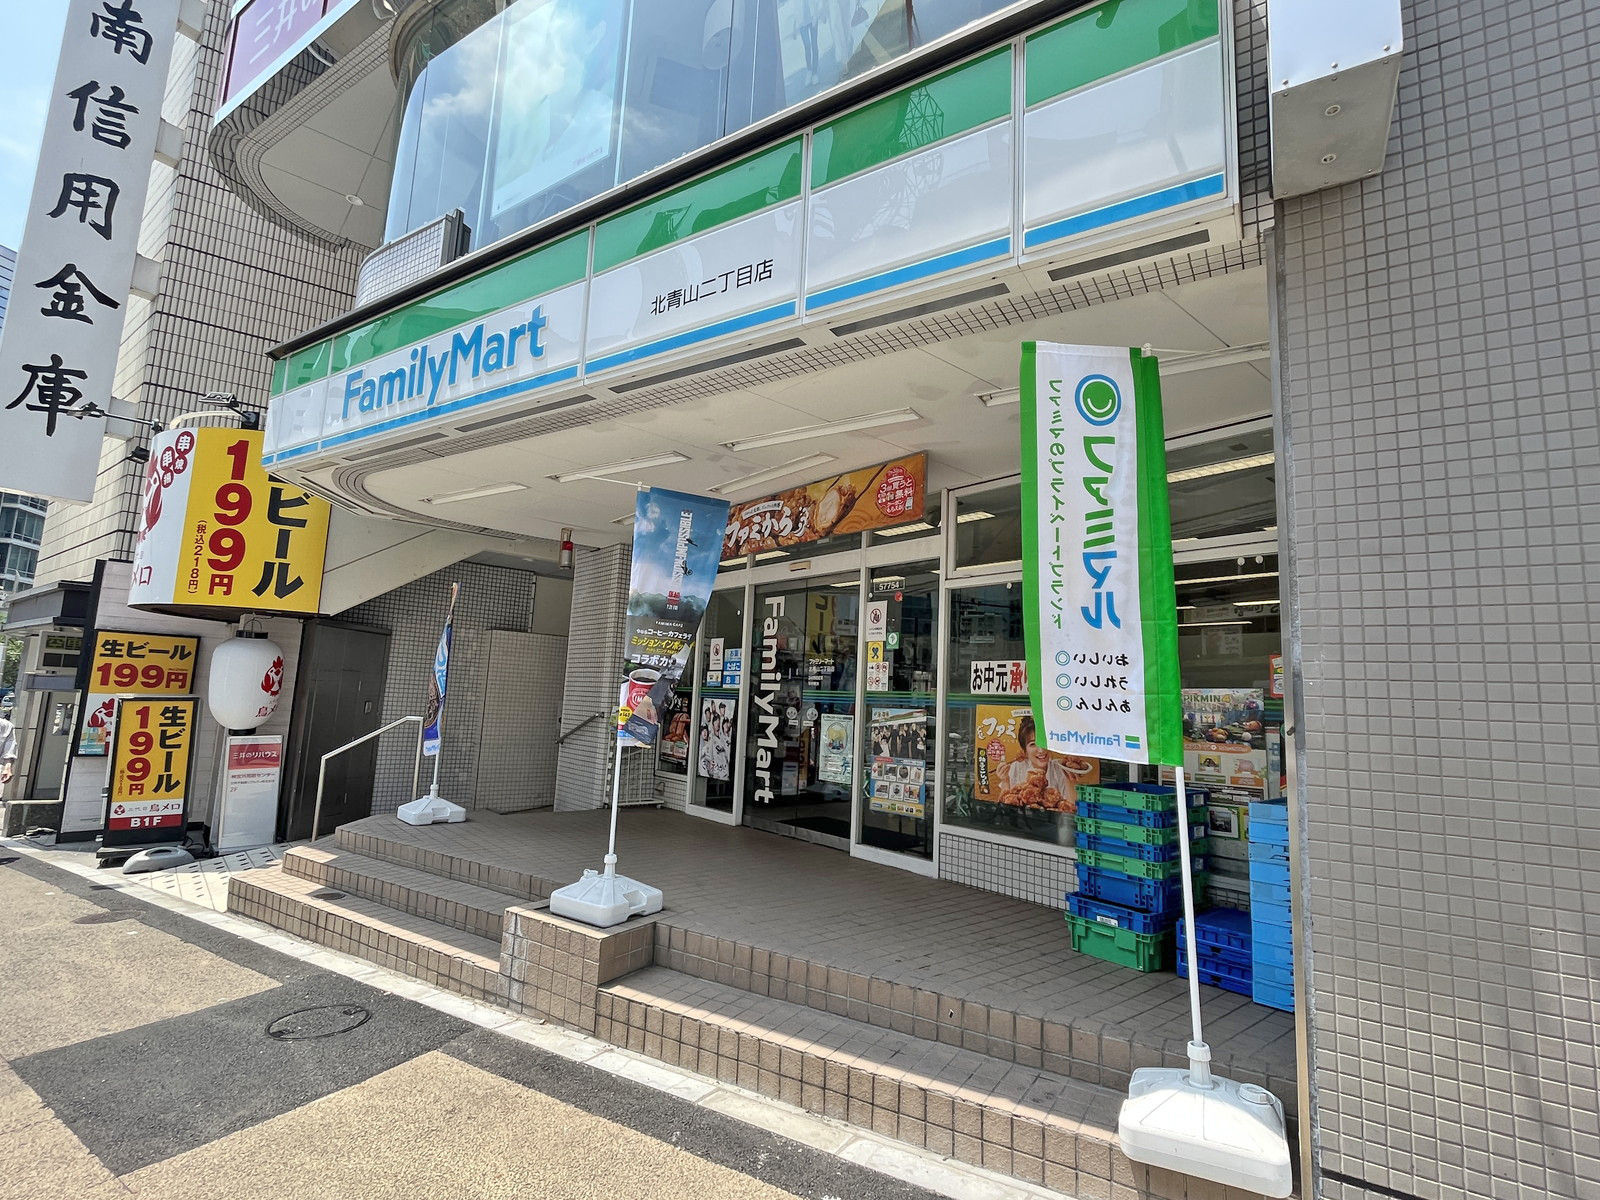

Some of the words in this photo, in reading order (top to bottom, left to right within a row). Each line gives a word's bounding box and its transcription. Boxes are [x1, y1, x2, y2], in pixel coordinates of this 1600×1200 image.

[650, 259, 775, 317] 北青山二丁目店
[341, 303, 549, 419] FamilyMart
[207, 440, 252, 595] 199円
[252, 474, 314, 599] ビール
[97, 663, 188, 689] 199円
[99, 640, 192, 660] 生ビール
[727, 662, 740, 670] たばこ
[754, 596, 786, 803] FamilyMart
[1183, 694, 1220, 703] PIKMIN
[1222, 694, 1231, 703] 4
[126, 706, 154, 795] 199円
[152, 706, 186, 793] 生ビール
[233, 751, 278, 759] 三井のリハウス
[130, 816, 162, 828] B1F
